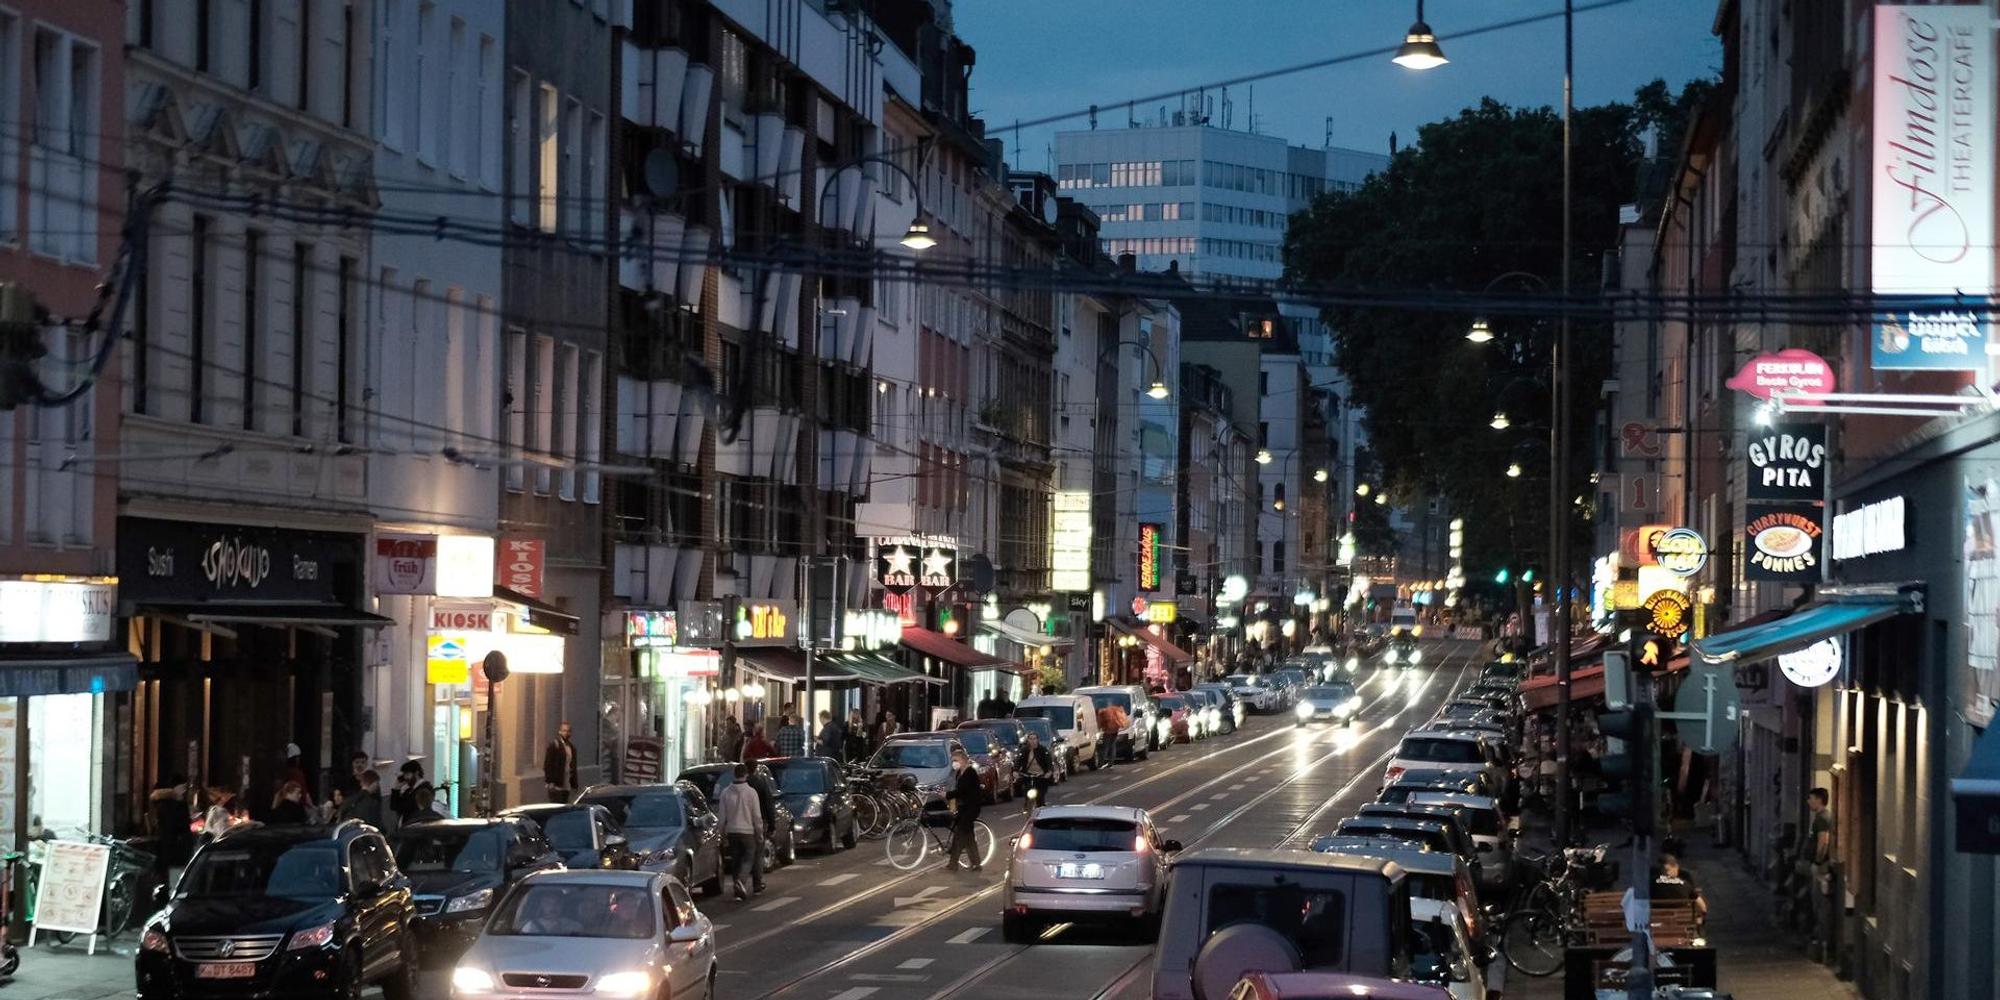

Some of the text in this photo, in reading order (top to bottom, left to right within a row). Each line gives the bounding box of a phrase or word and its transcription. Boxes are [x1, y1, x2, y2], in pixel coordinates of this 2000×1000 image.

[1948, 24, 1974, 193] THEATERCAFÉ
[1748, 434, 1824, 469] GYROS
[1762, 467, 1811, 487] PITA
[1747, 512, 1822, 539] CURRYWURST
[148, 546, 174, 577] Sushi
[293, 553, 318, 582] Ramen
[394, 560, 417, 573] früh
[510, 541, 537, 594] KIOSK
[1751, 550, 1816, 572] POMMES
[884, 575, 914, 586] BAR
[921, 576, 950, 587] BAR
[1071, 598, 1087, 607] sky
[434, 612, 490, 628] KIOSK
